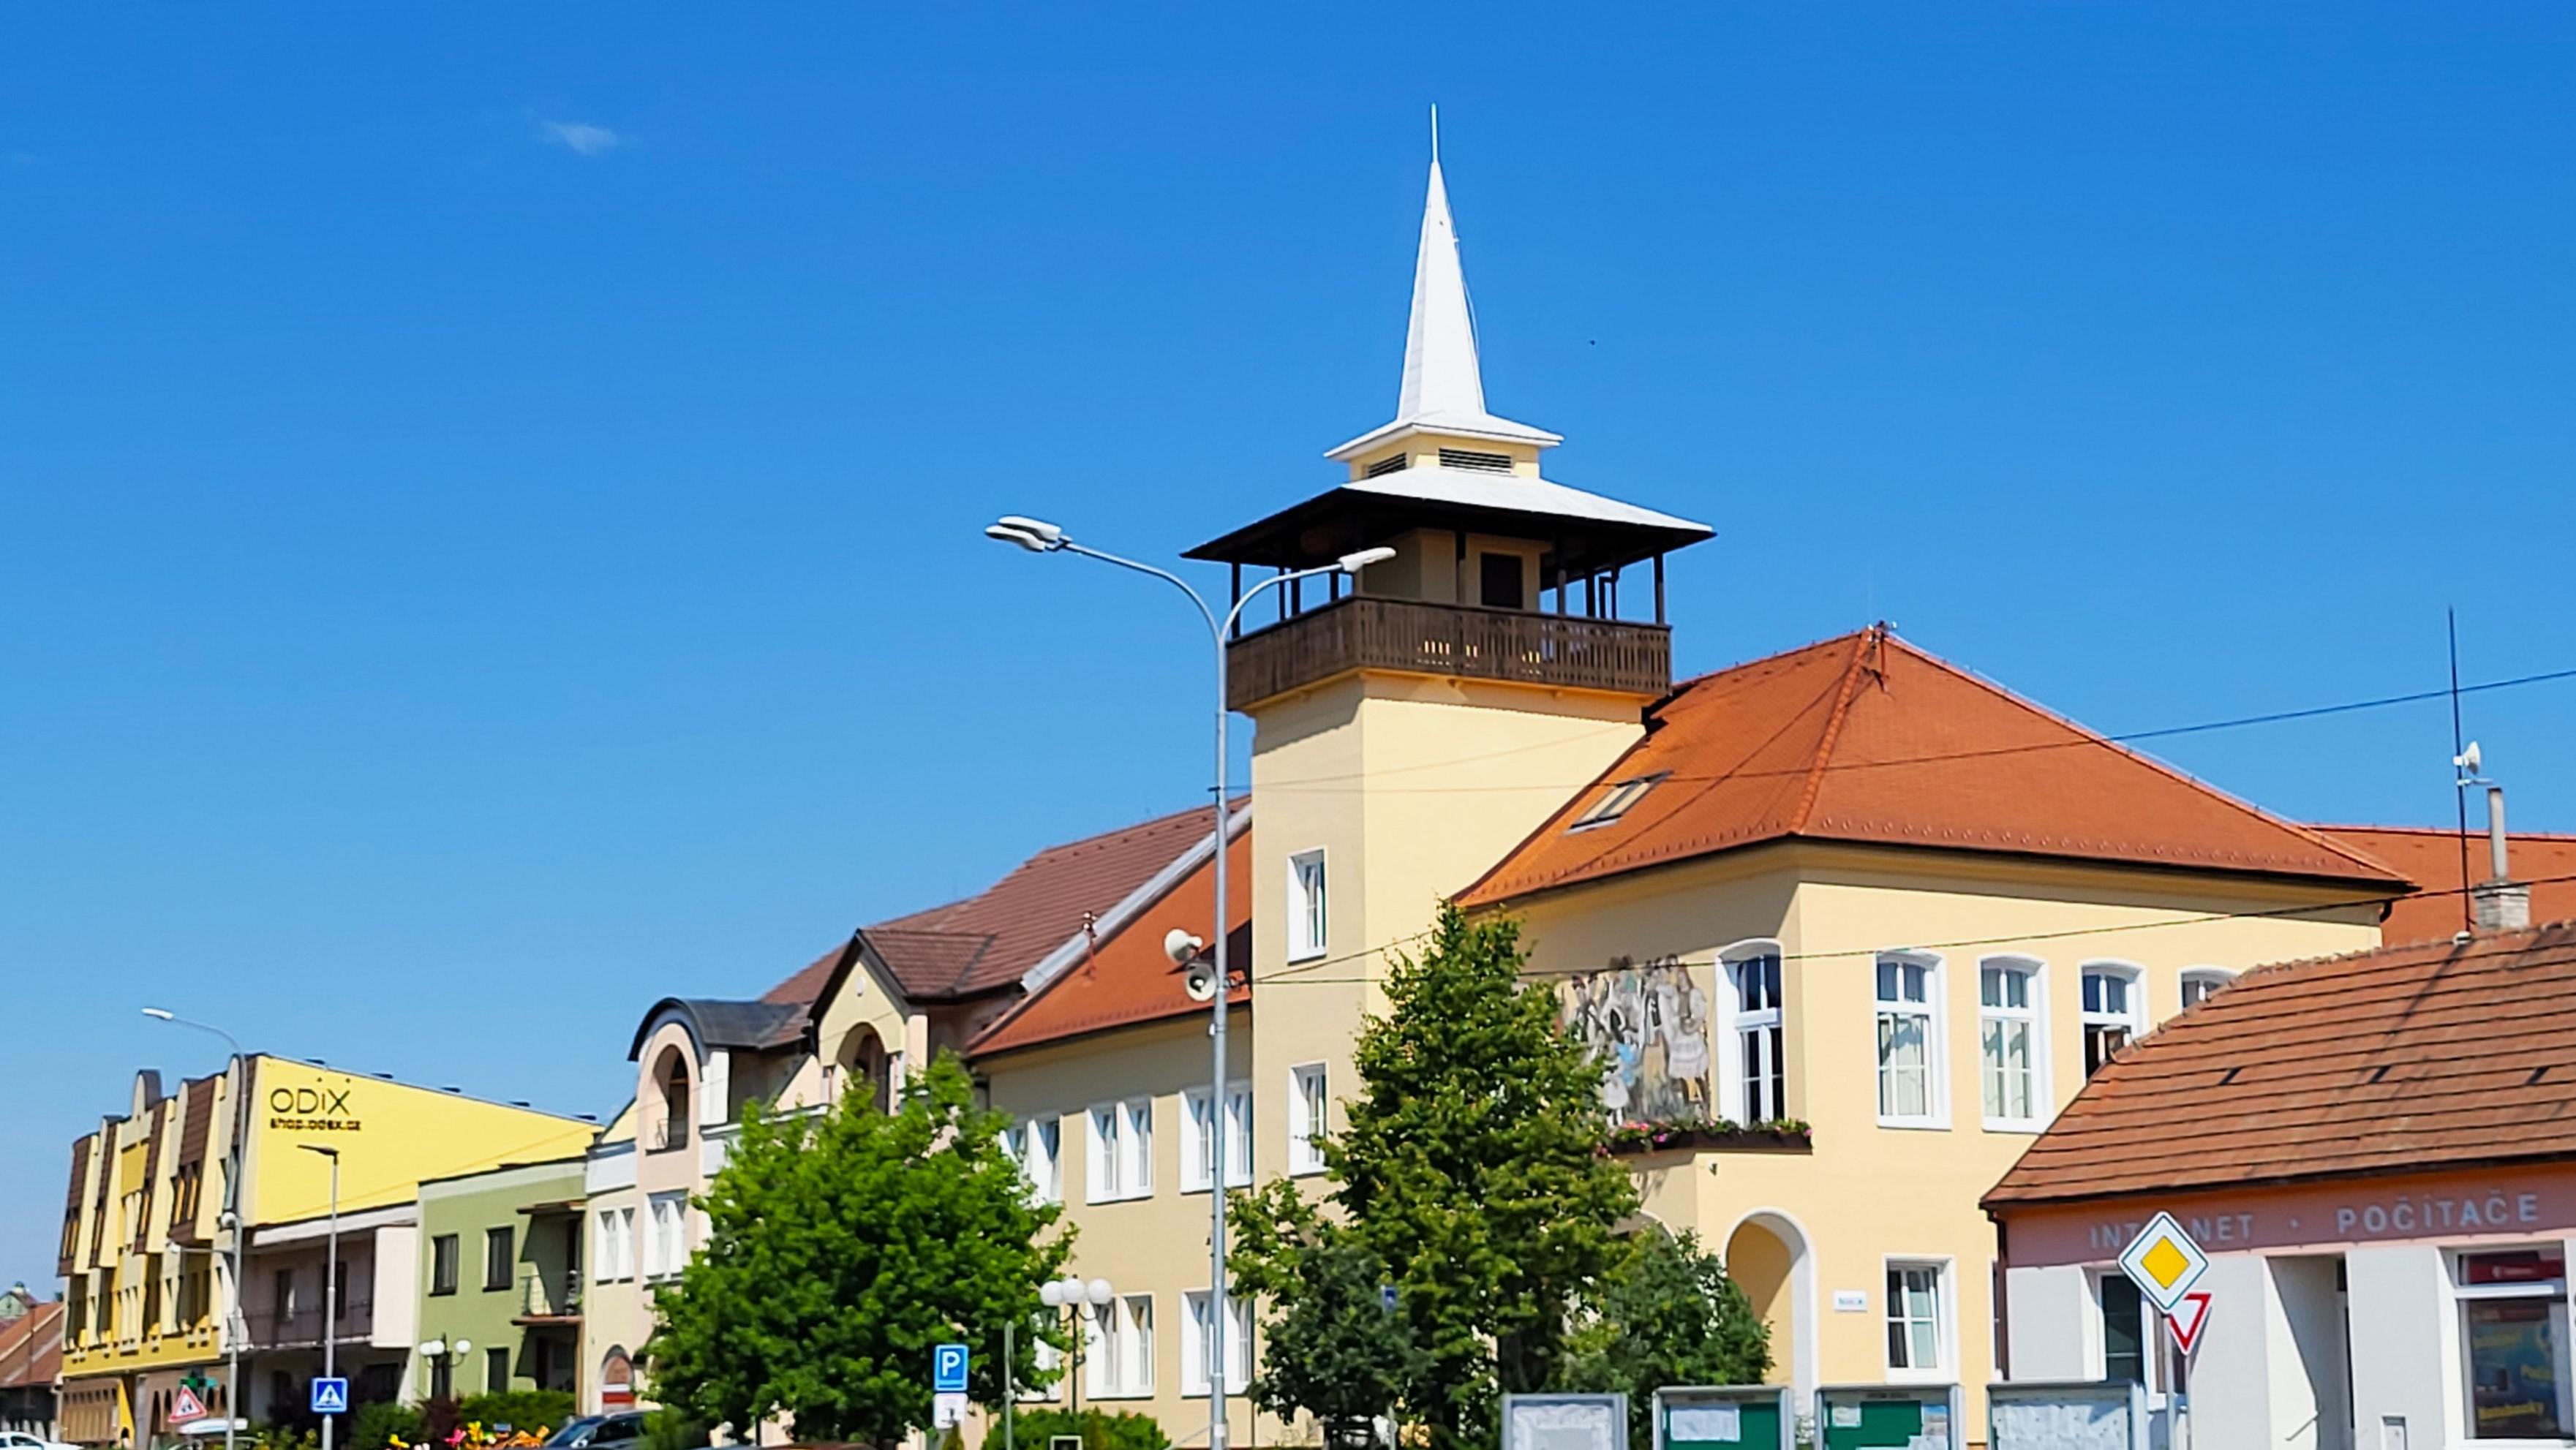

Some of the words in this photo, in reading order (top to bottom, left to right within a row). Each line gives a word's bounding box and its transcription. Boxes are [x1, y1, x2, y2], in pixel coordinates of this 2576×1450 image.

[2090, 1215, 2253, 1247] INTNET
[2336, 1188, 2539, 1234] POČÍTAČE
[942, 1351, 961, 1377] P
